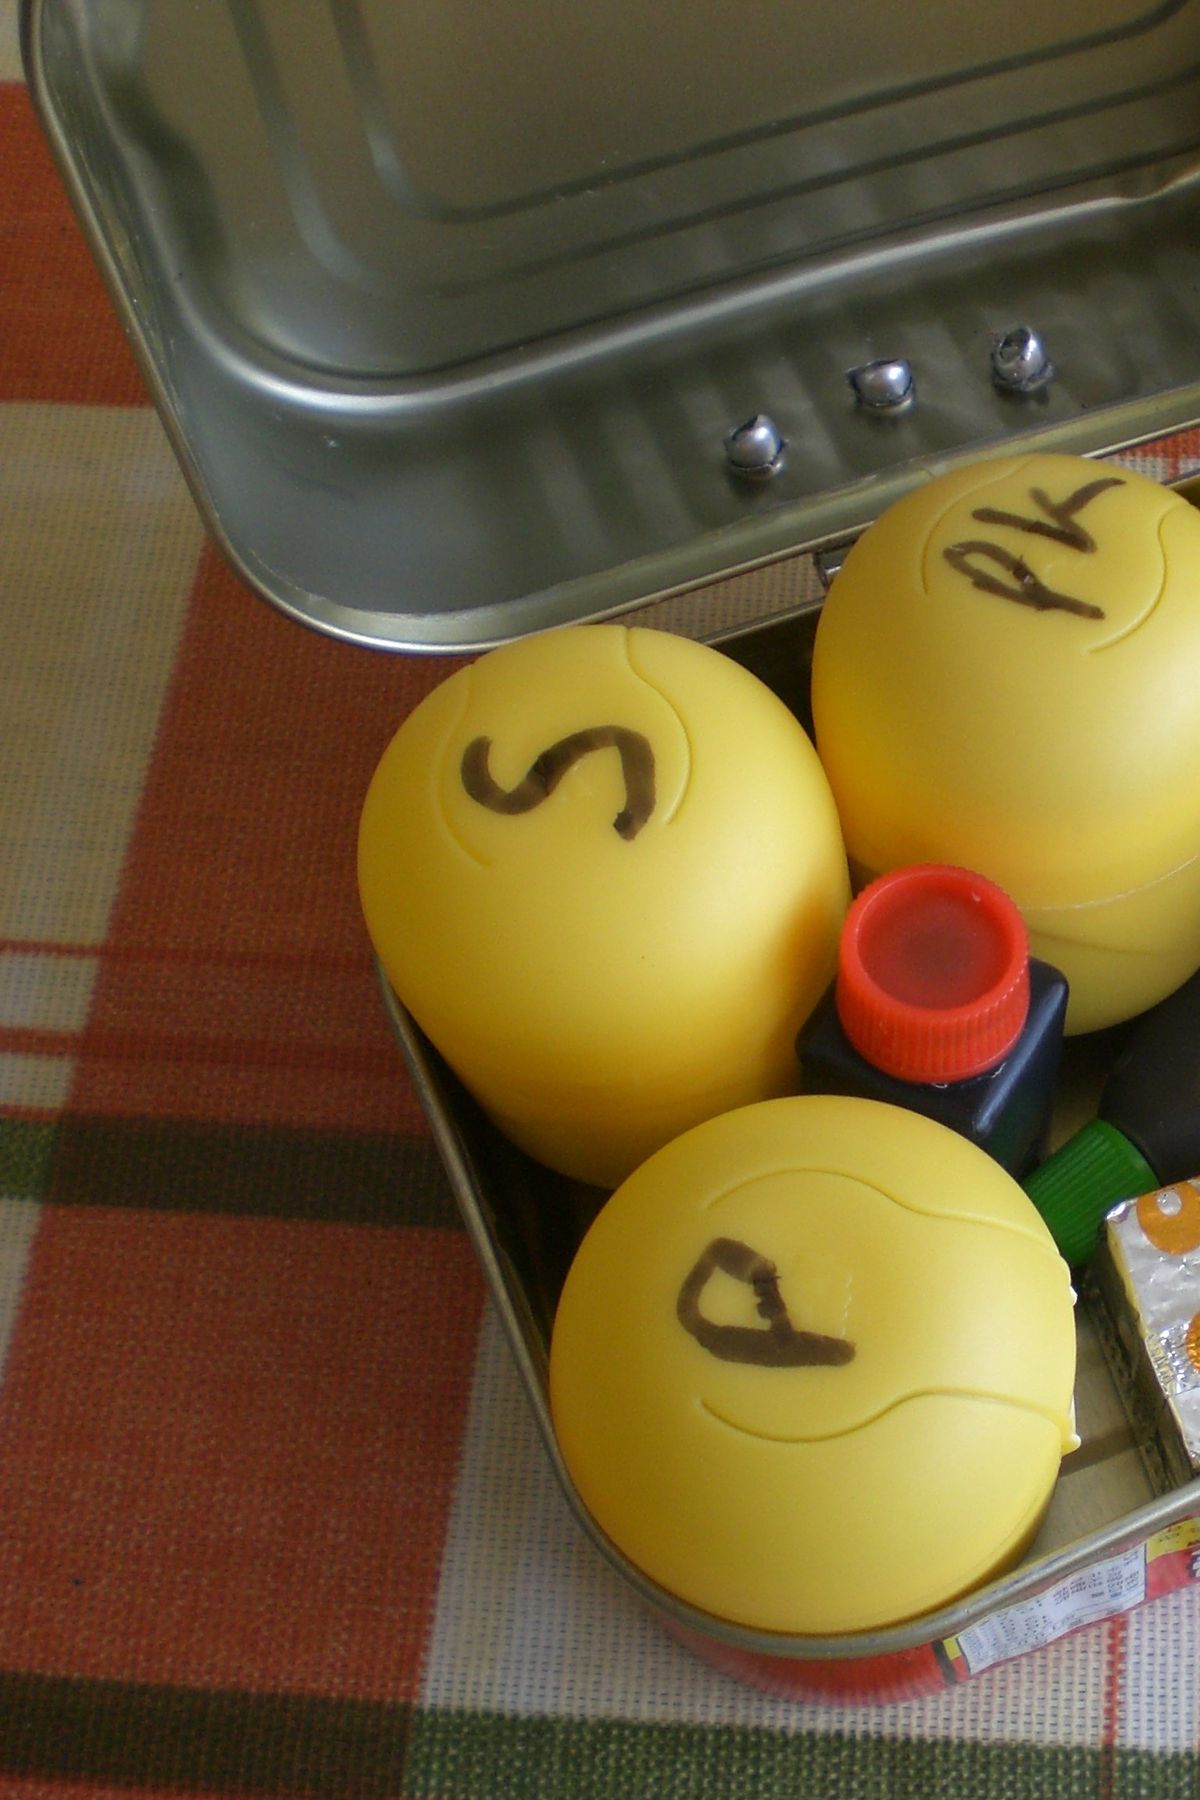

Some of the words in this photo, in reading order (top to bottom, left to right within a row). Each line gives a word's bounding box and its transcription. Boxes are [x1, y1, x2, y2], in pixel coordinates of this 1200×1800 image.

[942, 477, 1127, 620] PK
[461, 725, 657, 843] S
[677, 1237, 857, 1369] P
